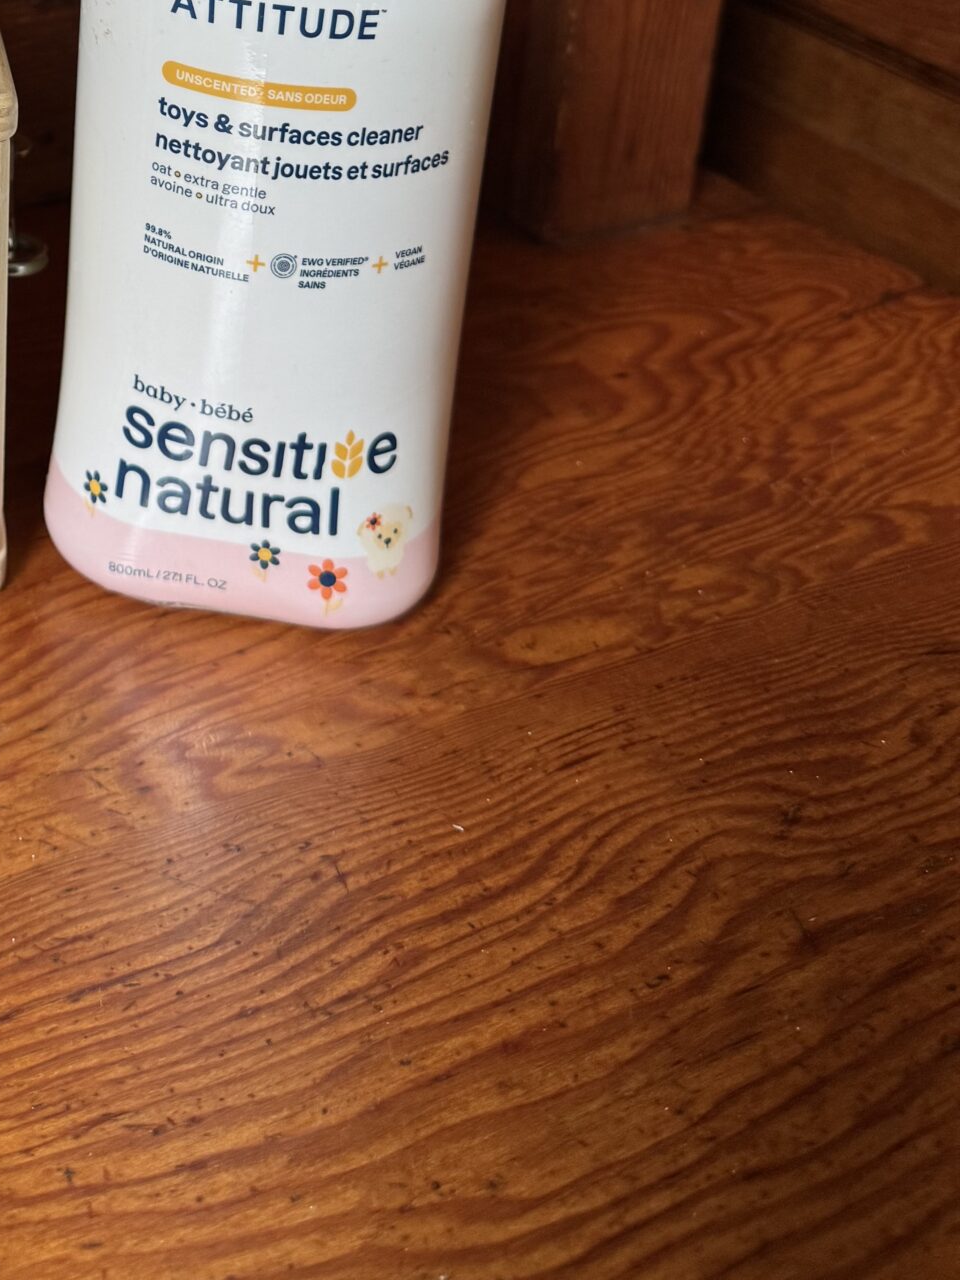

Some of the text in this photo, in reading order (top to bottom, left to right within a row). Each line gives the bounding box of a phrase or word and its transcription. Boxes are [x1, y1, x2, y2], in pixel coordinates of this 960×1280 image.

[175, 68, 348, 106] UNSCENTED SANS ODEUR
[158, 96, 423, 147] toys & surfaces cleaner
[155, 131, 449, 181] nettoyant jouets et surfaces
[150, 174, 276, 216] avoine ultra doux
[151, 161, 267, 201] oat extra gentle
[145, 222, 172, 240] 99.8%
[143, 233, 225, 266] NATURAL ORIGIN
[143, 245, 190, 269] D'ORIGINE
[190, 262, 250, 283] NATURELLE
[301, 257, 324, 267] EWG
[393, 254, 426, 272] VÉGANE
[394, 245, 424, 260] VEGAN
[297, 280, 327, 290] SAINS
[299, 267, 360, 278] INGRÉDIENTS
[133, 374, 254, 424] baby bébé
[114, 457, 340, 537] natural
[108, 560, 154, 579] 800mL
[185, 573, 205, 587] FL.
[207, 577, 228, 591] OZ
